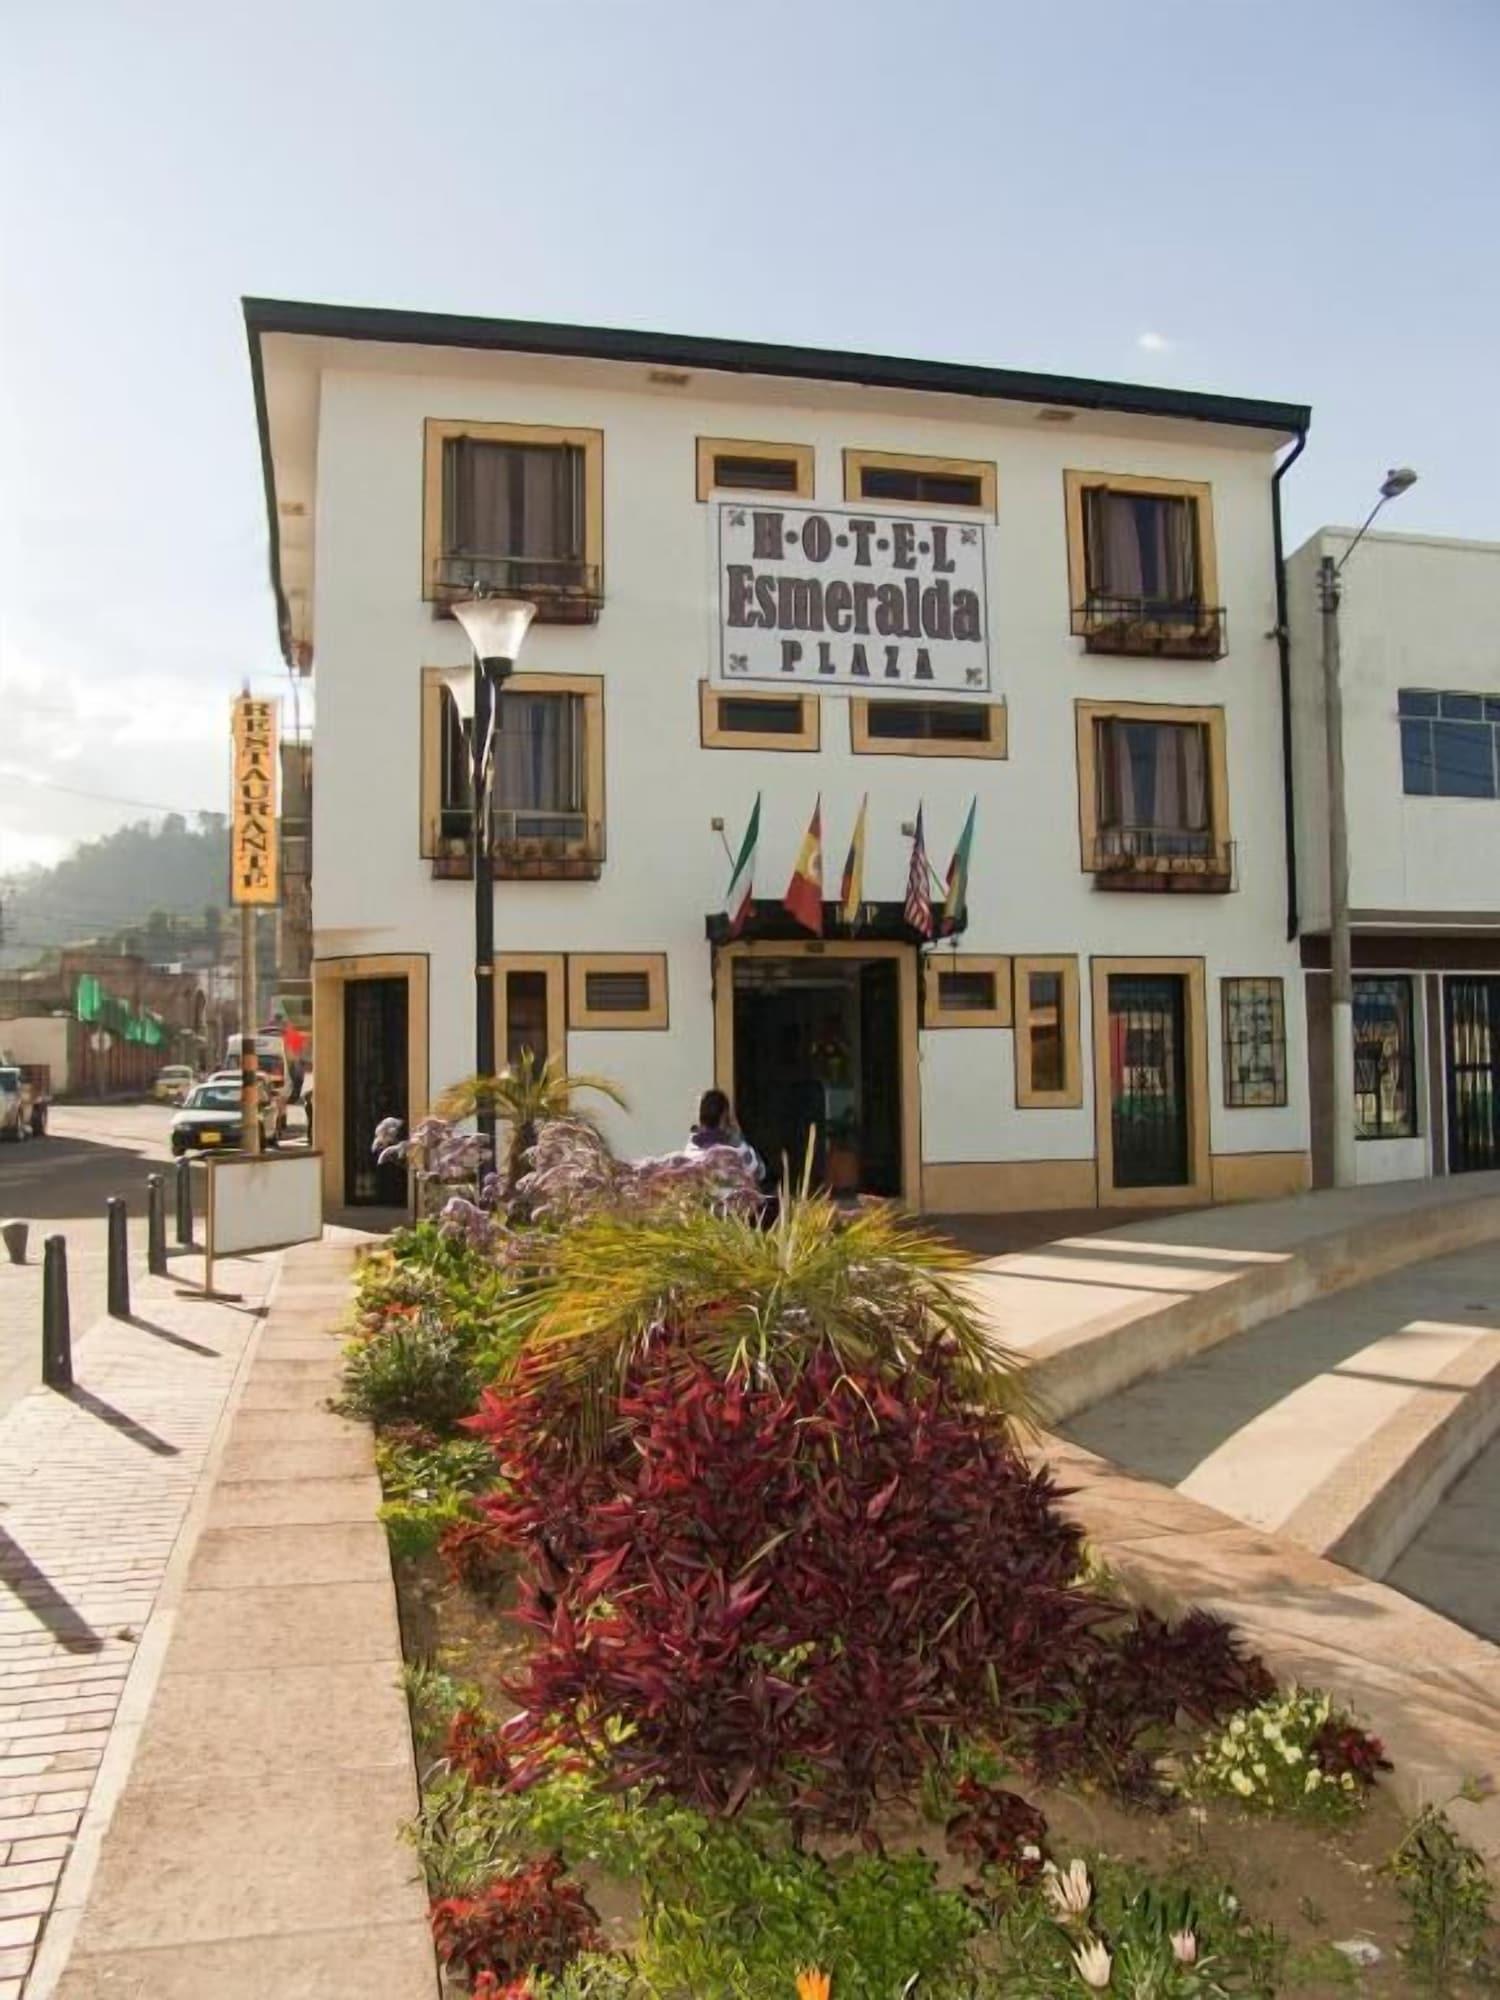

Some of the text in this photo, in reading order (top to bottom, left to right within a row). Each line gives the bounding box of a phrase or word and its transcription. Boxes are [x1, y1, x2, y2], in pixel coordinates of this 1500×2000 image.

[727, 564, 982, 642] Esmeralda
[781, 640, 934, 679] PLAZA
[241, 703, 271, 888] RESTAURANTE
